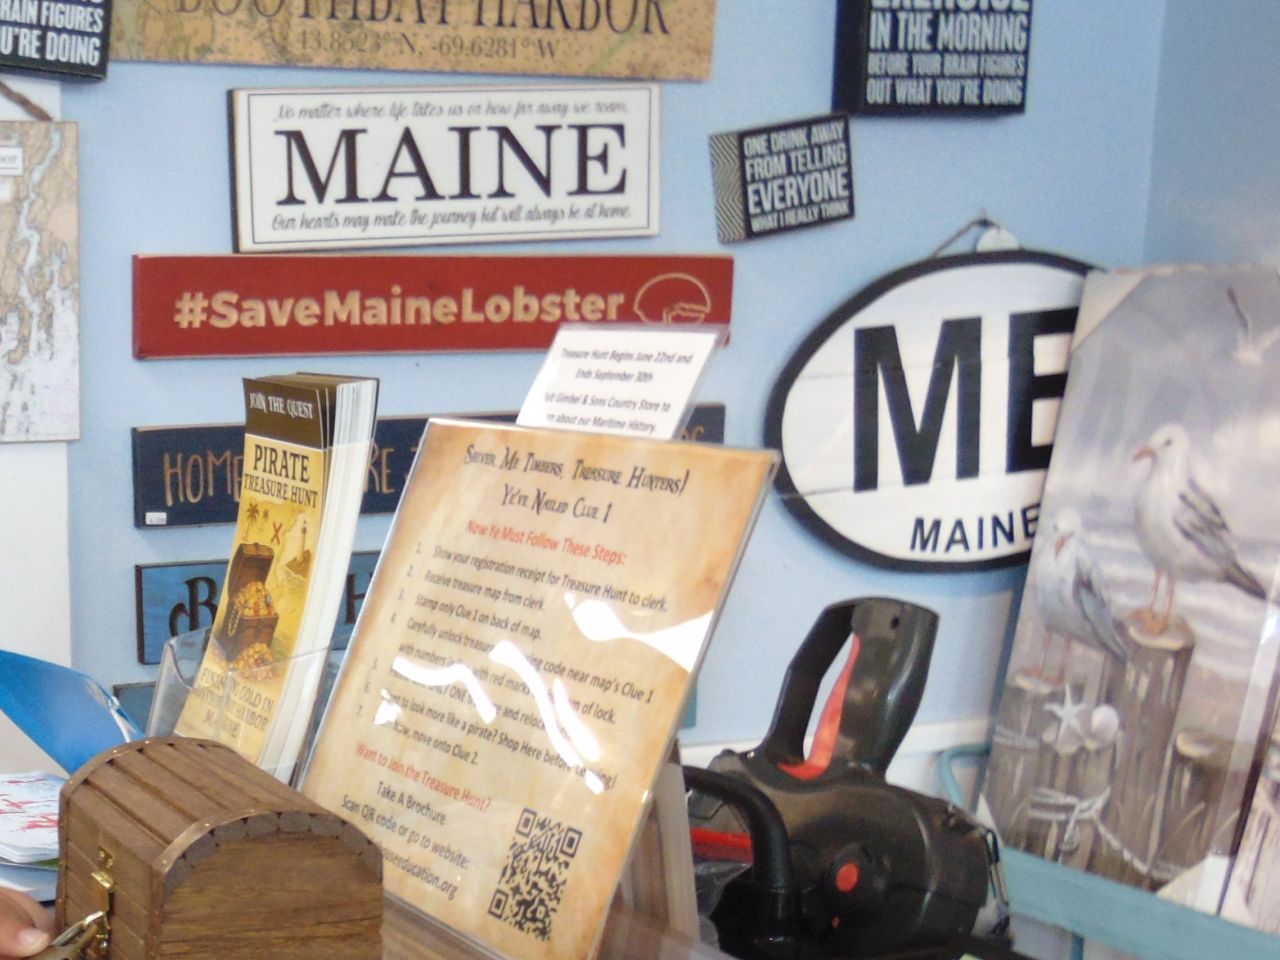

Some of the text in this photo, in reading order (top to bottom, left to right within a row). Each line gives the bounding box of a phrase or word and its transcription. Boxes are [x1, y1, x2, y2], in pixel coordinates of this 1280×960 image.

[41, 0, 104, 33] FIGURES
[869, 10, 1027, 52] IN THE MORNING
[45, 32, 101, 67] DOING
[866, 78, 1023, 105] OUT WHAT YOU'RE DOING
[743, 134, 769, 157] ONE
[770, 128, 808, 153] DRINK
[745, 142, 847, 182] FROM TELLING
[274, 123, 627, 206] MAINE
[747, 167, 849, 215] EVERYONE
[173, 283, 626, 330] #SaveMaineLobster
[249, 392, 314, 420] JOIN THE QUEST
[853, 307, 1079, 492] ME
[163, 449, 244, 506] HOME
[253, 444, 310, 484] PIRATE
[244, 473, 318, 509] TREASURE HUNT
[603, 502, 613, 523] 1
[910, 504, 1040, 553] MAINE
[466, 520, 487, 535] Now
[501, 527, 524, 544] Must
[525, 531, 560, 550] Follow
[561, 538, 590, 557] These
[592, 545, 627, 565] Steps:
[425, 570, 452, 587] Receive
[453, 577, 482, 596] treasure
[484, 586, 501, 600] map
[470, 556, 515, 576] registration
[516, 566, 546, 584] receipt
[546, 571, 560, 586] for
[562, 574, 601, 595] Treasure
[602, 584, 627, 601] Hunt
[629, 592, 640, 605] to
[489, 669, 504, 685] red
[582, 702, 594, 714] of
[544, 661, 566, 676] code
[567, 668, 589, 683] near
[590, 674, 620, 693] map's
[621, 682, 645, 701] Clue
[502, 707, 520, 720] and
[452, 744, 470, 761] Clue
[466, 724, 498, 742] pirate?
[498, 732, 520, 753] Shop
[520, 741, 542, 760] Here
[377, 781, 447, 825] Take Brochure
[421, 771, 461, 800] Treasure
[461, 788, 493, 813] Hunt?
[341, 795, 360, 814] Scan
[361, 804, 376, 822] QR
[376, 814, 396, 832] code
[398, 824, 408, 836] or
[420, 835, 431, 849] to
[432, 842, 470, 870] website:
